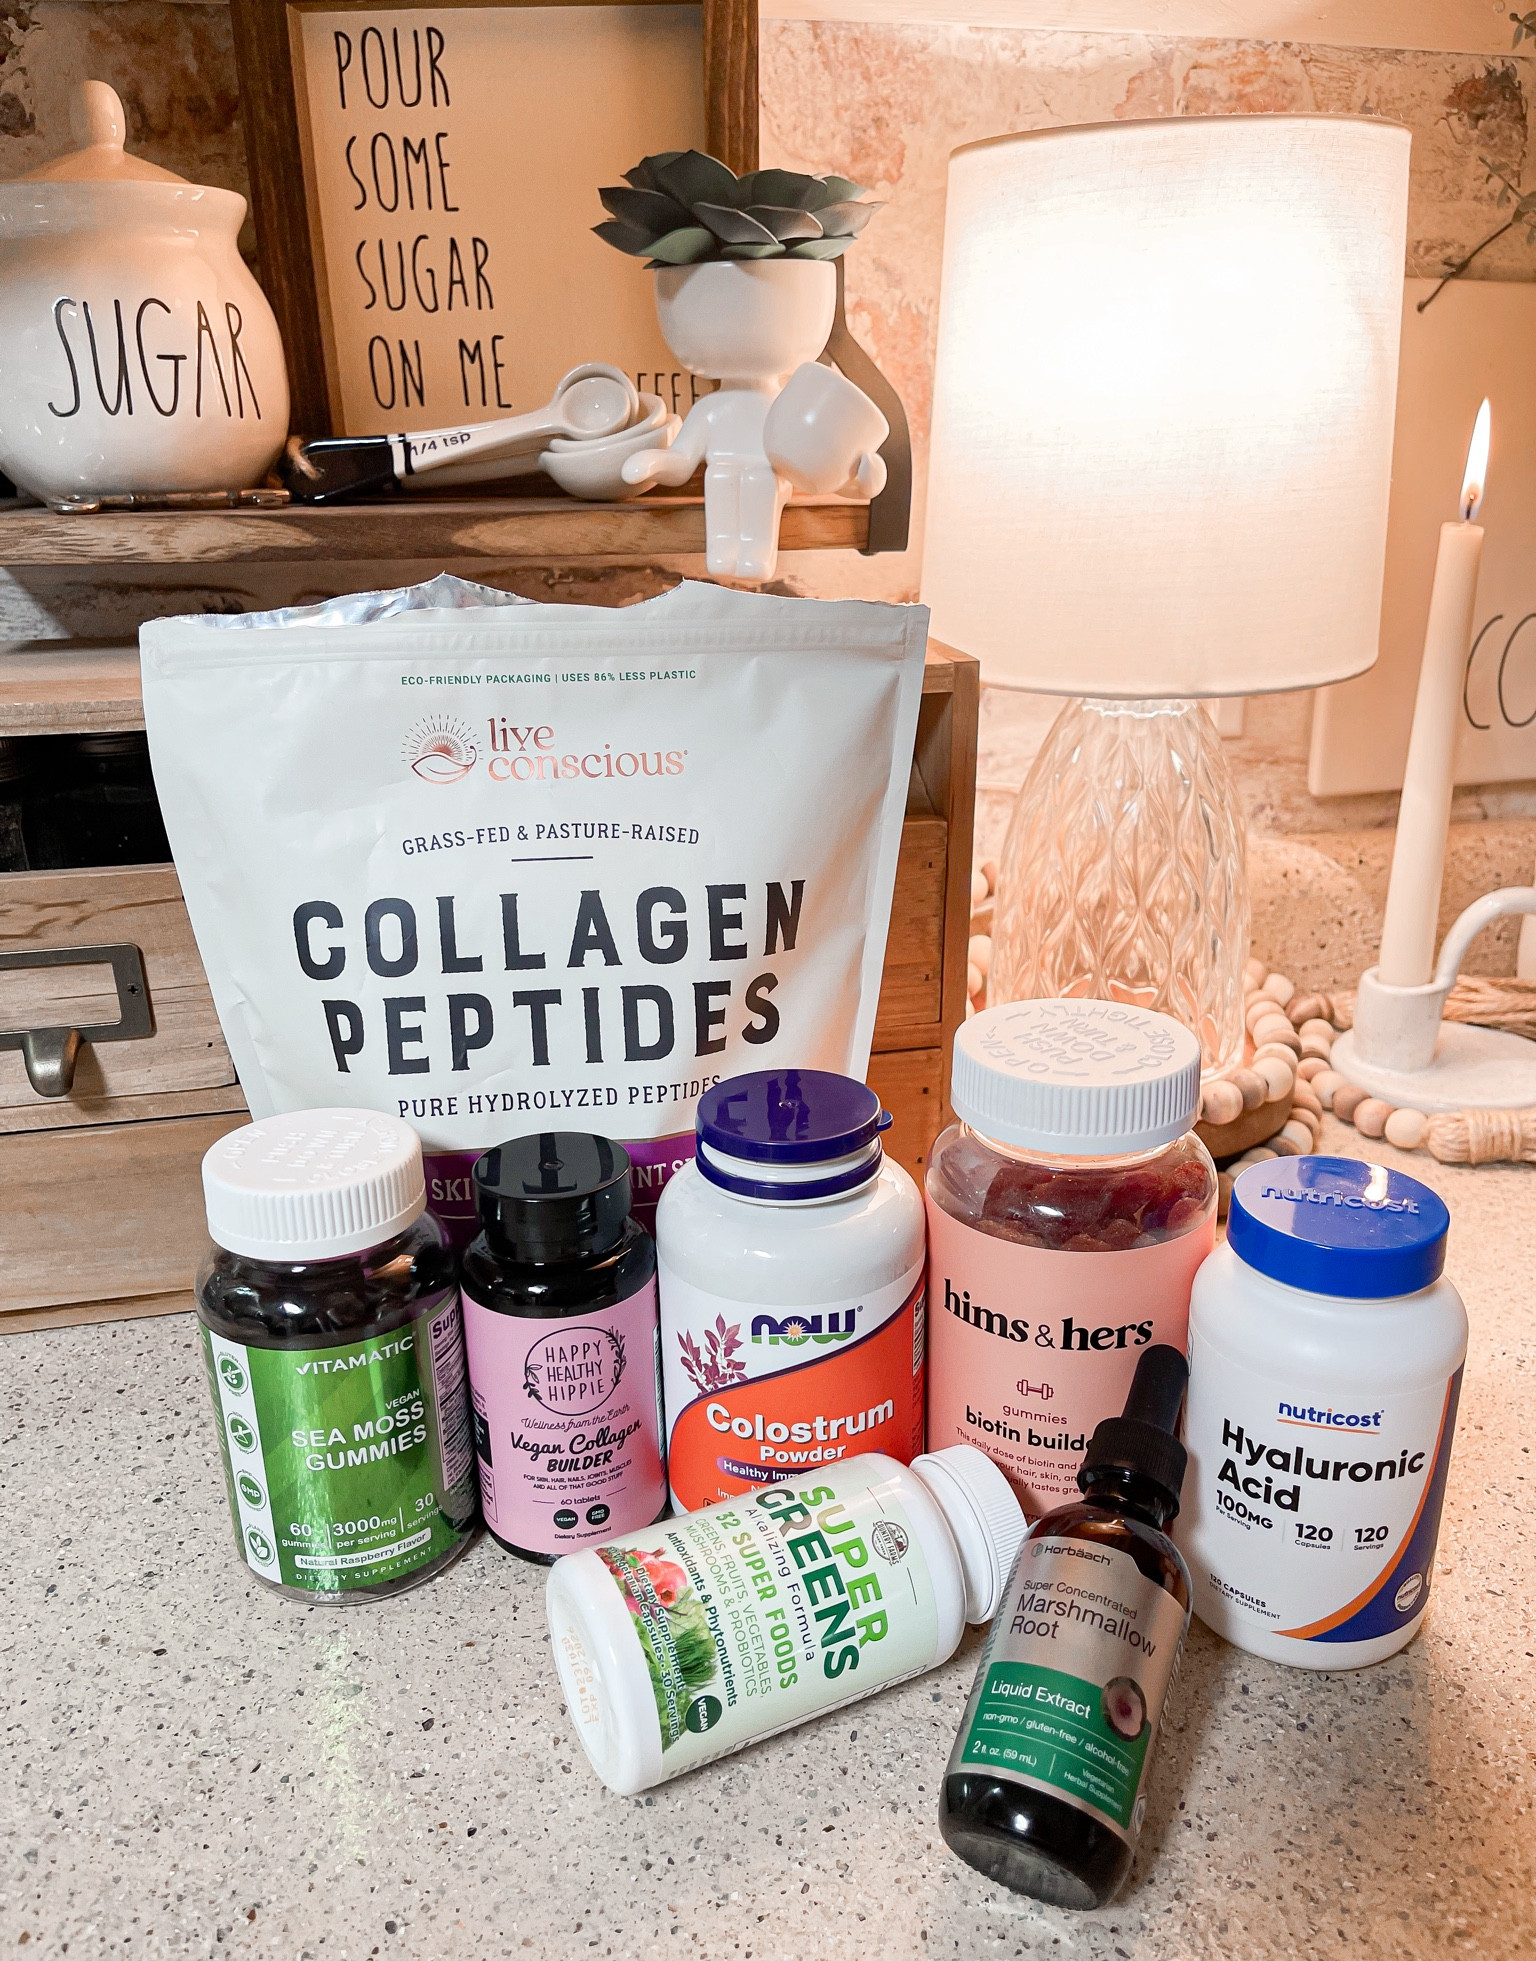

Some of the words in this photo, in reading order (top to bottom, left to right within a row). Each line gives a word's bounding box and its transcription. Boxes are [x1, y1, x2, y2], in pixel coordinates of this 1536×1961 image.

[334, 26, 450, 109] POUR
[346, 132, 460, 213] SOME
[356, 235, 495, 312] SUGAR
[48, 297, 262, 420] SUGAR
[368, 335, 425, 411] ON
[458, 334, 513, 410] ME
[443, 433, 471, 447] tsp
[401, 674, 482, 686] ECO-FRIENDLY
[486, 673, 551, 684] PACKAGING
[561, 672, 590, 683] USES
[594, 671, 615, 682] 86%
[619, 670, 646, 681] LESS
[650, 670, 697, 680] PLASTIC
[487, 717, 556, 752] live
[488, 743, 685, 782] conscious
[402, 825, 510, 856] GRASS-FED
[517, 824, 529, 841] &
[535, 822, 700, 846] PASTURE-RAISED
[292, 880, 806, 981] COLLAGEN
[322, 972, 781, 1075] PEPTIDES
[398, 1096, 459, 1119] PURE
[468, 1087, 619, 1114] HYDROLYZED
[431, 1177, 471, 1201] SKI
[1261, 1183, 1421, 1214] nutricost
[943, 1277, 1030, 1343] hims
[1034, 1323, 1056, 1349] &
[1060, 1316, 1154, 1351] hers
[545, 1339, 602, 1363] HAPPY
[547, 1359, 603, 1382] HEALTHY
[385, 1388, 420, 1410] VEGAN
[548, 1378, 605, 1402] HIPPIE
[292, 1428, 346, 1448] SEA
[353, 1400, 425, 1442] MOSS
[521, 1417, 566, 1431] Wellness
[563, 1418, 592, 1432] from
[592, 1414, 607, 1425] the
[706, 1399, 895, 1444] Colostrum
[966, 1404, 1021, 1443] biotin
[1028, 1428, 1092, 1451] build
[1003, 1405, 1068, 1425] gummies
[1278, 1402, 1382, 1428] nutricost
[305, 1424, 427, 1472] GUMMIES
[510, 1431, 566, 1462] Vegan
[569, 1419, 643, 1455] Collagen
[760, 1444, 847, 1464] Powder
[956, 1426, 970, 1441] This
[972, 1437, 991, 1452] daily
[993, 1445, 1014, 1460] dose
[1016, 1454, 1026, 1463] of
[1028, 1457, 1055, 1469] biotin
[1057, 1462, 1077, 1470] and
[1221, 1417, 1426, 1483] Hyaluronic
[524, 1473, 536, 1481] FOR
[546, 1449, 613, 1473] BUILDER
[723, 1460, 769, 1481] Healthy
[1017, 1465, 1038, 1478] hair,
[1040, 1471, 1061, 1482] skin,
[573, 1494, 601, 1505] tablets
[585, 1478, 607, 1488] GOOD
[1031, 1481, 1060, 1493] tastes
[1217, 1457, 1301, 1513] Acid
[407, 1505, 443, 1529] servings
[415, 1492, 434, 1512] 30
[1216, 1489, 1274, 1530] 100MG
[289, 1522, 312, 1537] 60
[332, 1515, 398, 1537] 3000mg
[1227, 1512, 1251, 1530] Serving
[1295, 1523, 1334, 1542] 120
[1354, 1525, 1389, 1543] 120
[300, 1557, 338, 1566] Natural
[340, 1548, 395, 1566] Raspberry
[397, 1532, 427, 1552] Flavor
[336, 1539, 355, 1549] per
[357, 1528, 396, 1545] serving
[887, 1544, 900, 1565] FARMS
[1294, 1539, 1331, 1550] Capsules
[1353, 1542, 1384, 1551] Servings
[354, 1546, 432, 1579] SUPPLEMENT
[665, 1532, 706, 1592] Antioxidants
[683, 1525, 731, 1596] MUSHROOMS
[799, 1486, 889, 1649] SUPER
[701, 1594, 713, 1605] &
[715, 1511, 742, 1530] 32
[732, 1532, 778, 1602] SUPER
[765, 1607, 798, 1690] FOODS
[745, 1508, 792, 1578] Alkalizing
[786, 1583, 815, 1662] Formula
[755, 1489, 860, 1680] GREENS
[1023, 1580, 1054, 1592] Super
[1056, 1581, 1138, 1620] Concentrated
[1209, 1573, 1222, 1586] 120
[1223, 1582, 1267, 1609] CAPSULES
[695, 1517, 726, 1555] GREENS,
[720, 1554, 749, 1604] FRUITS,
[743, 1603, 772, 1698] VEGETABLES,
[724, 1597, 736, 1609] &
[1235, 1598, 1281, 1620] SUPPLEMENT
[636, 1566, 660, 1606] Dietary
[655, 1607, 686, 1691] Supplement
[639, 1601, 665, 1663] Capsules
[1009, 1615, 1060, 1639] Root
[1016, 1593, 1157, 1658] Marshmallow
[705, 1606, 738, 1708] Phytonutrients
[728, 1610, 758, 1698] PROBIOTICS
[661, 1669, 672, 1688] 30
[665, 1689, 681, 1742] Servings
[697, 1697, 710, 1732] VEGAN
[991, 1680, 1034, 1698] Liquid
[1035, 1686, 1091, 1719] Extract
[972, 1740, 981, 1754] 2
[1003, 1748, 1018, 1761] (59
[1019, 1753, 1038, 1767] mL)
[983, 1712, 1019, 1725] non-gmo
[1026, 1718, 1078, 1744] gluten-free
[1085, 1741, 1130, 1777] alcohol-free
[1063, 1770, 1088, 1789] Herbal
